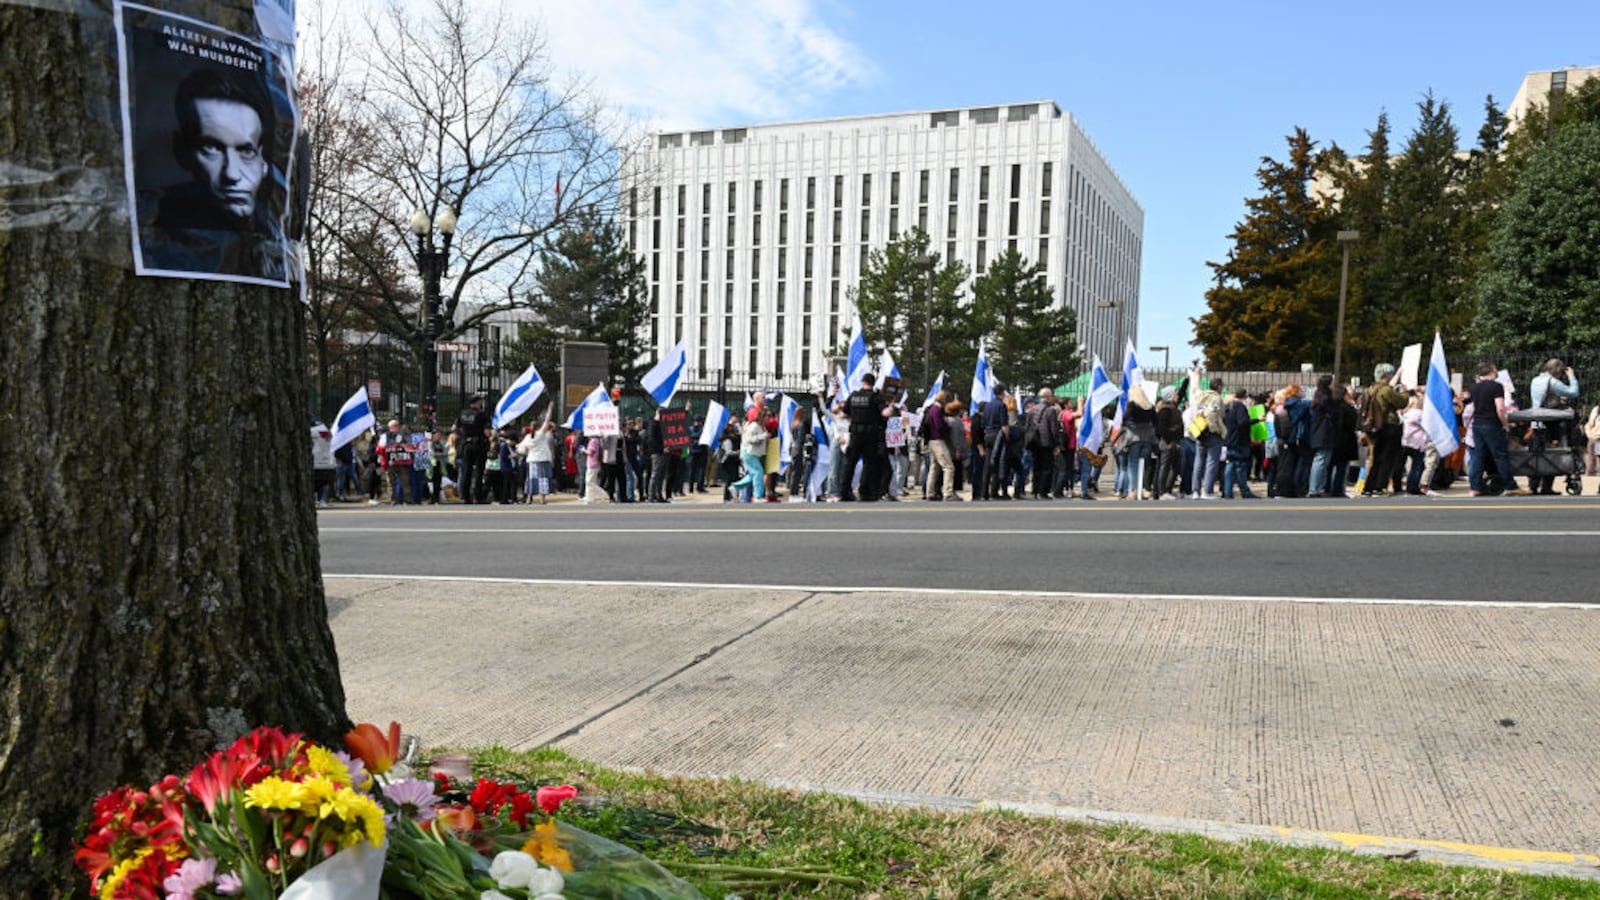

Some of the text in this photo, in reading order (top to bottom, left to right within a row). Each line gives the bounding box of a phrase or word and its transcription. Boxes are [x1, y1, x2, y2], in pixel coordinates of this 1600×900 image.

[163, 24, 262, 63] ALEXEY NAVALNY
[168, 39, 195, 54] WAS
